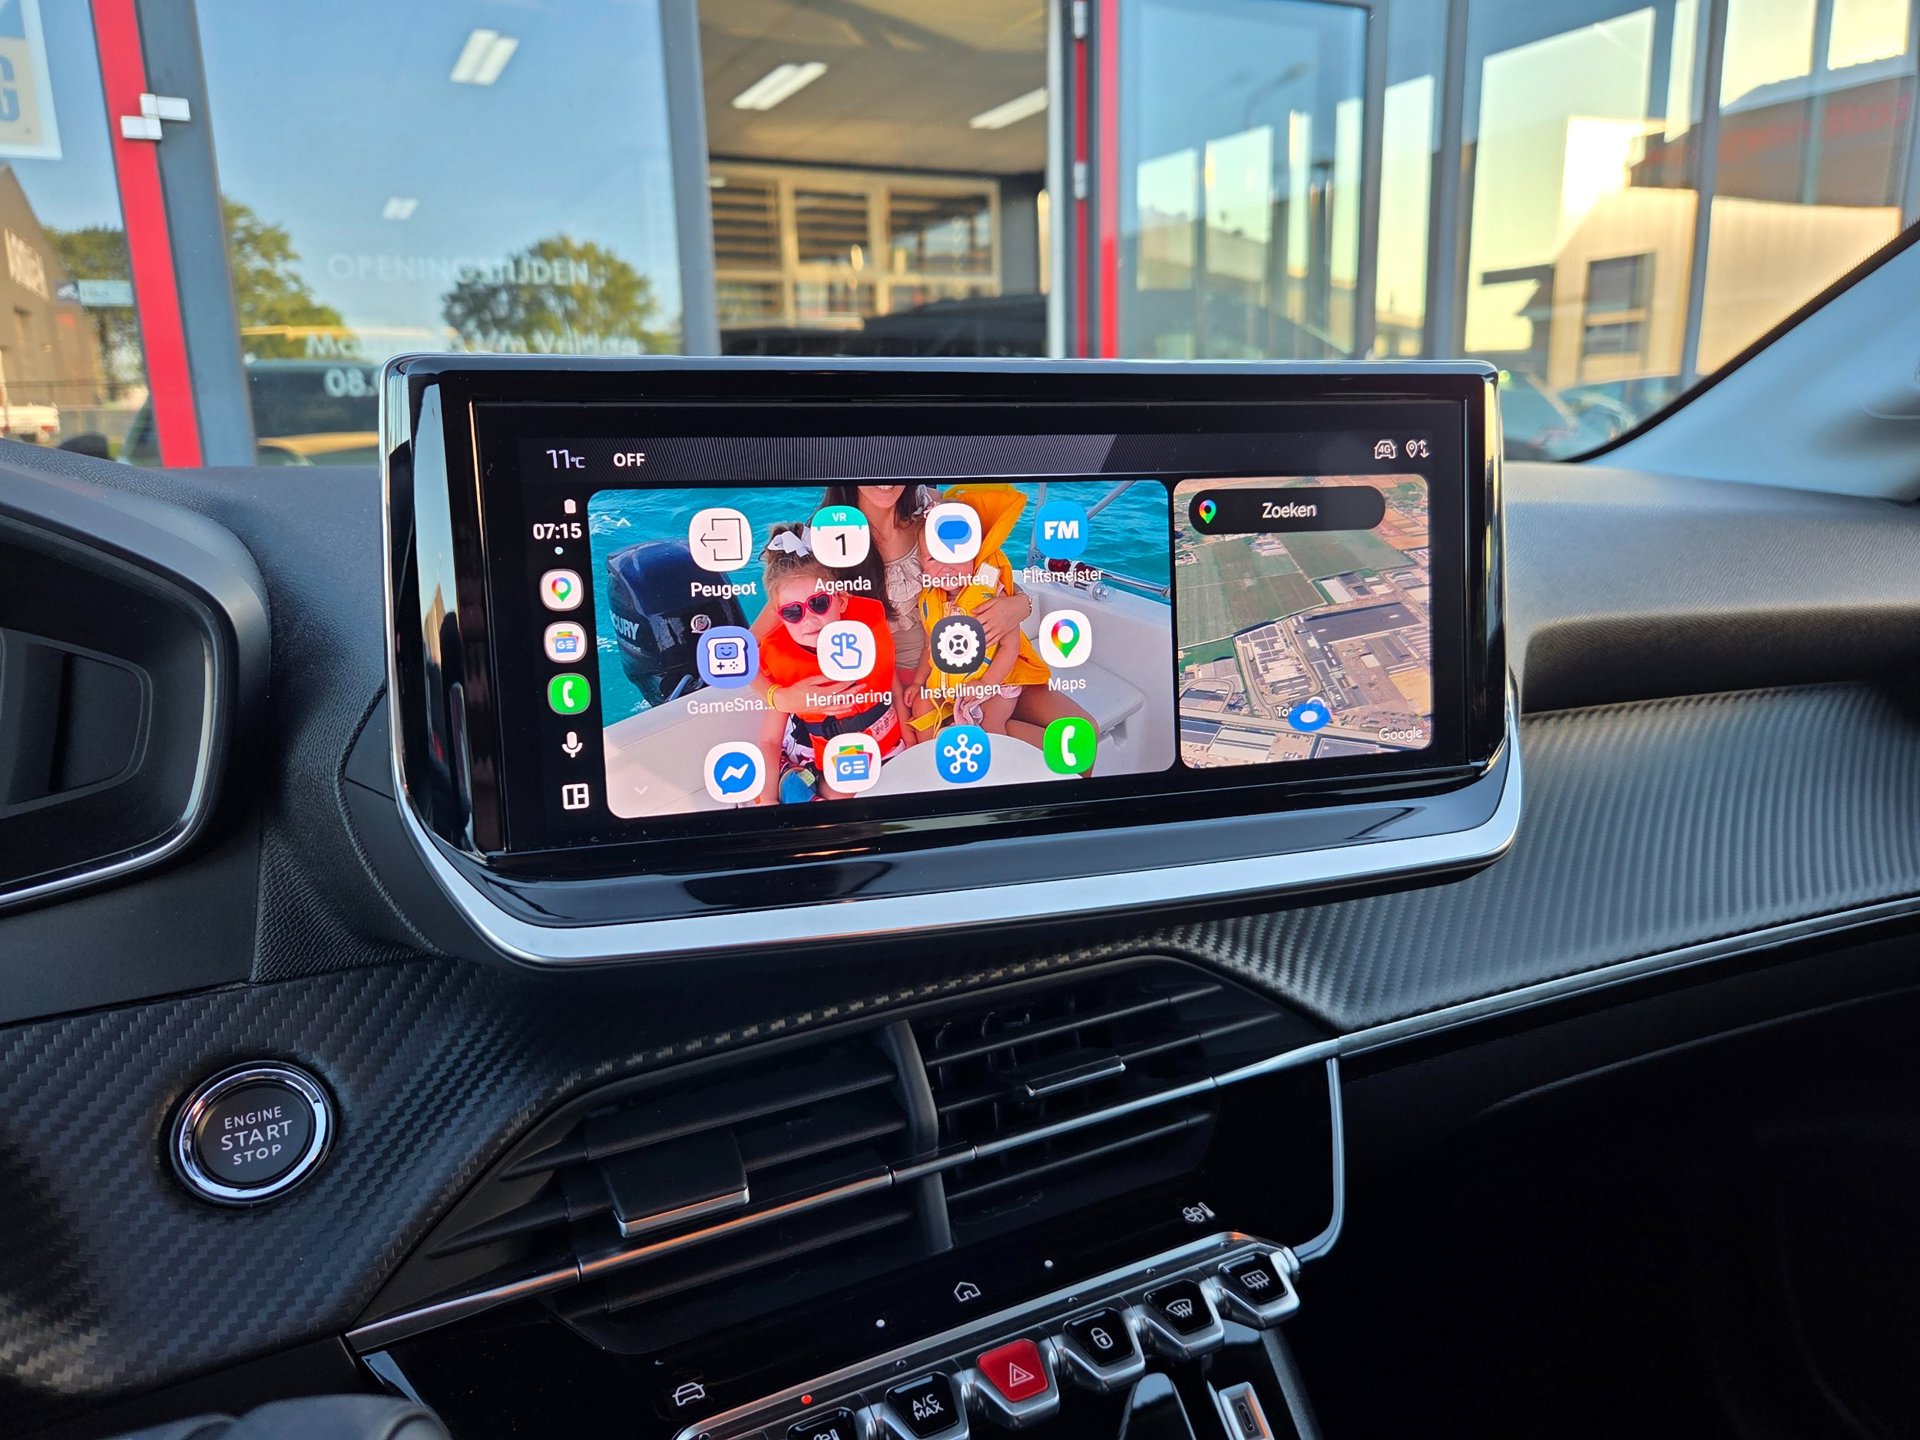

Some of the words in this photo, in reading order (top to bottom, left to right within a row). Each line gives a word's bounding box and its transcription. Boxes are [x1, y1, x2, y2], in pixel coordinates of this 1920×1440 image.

[324, 367, 382, 397] 08.
[613, 453, 645, 467] OFF
[831, 512, 847, 522] VR
[1262, 502, 1317, 519] Zoeken
[533, 523, 582, 540] 07:15
[1044, 520, 1079, 540] FM
[835, 533, 846, 556] 1
[815, 576, 872, 595] Agenda
[922, 569, 989, 588] Berichten
[1023, 568, 1103, 584] Flitsmeister
[691, 581, 757, 600] Peugeot
[920, 682, 1001, 700] Instellingen
[1048, 677, 1086, 692] Maps
[806, 689, 892, 707] Herinnering
[1378, 726, 1423, 742] Google
[224, 1106, 282, 1129] ENGINE
[221, 1120, 293, 1151] START
[233, 1144, 282, 1165] STOP
[912, 1393, 937, 1412] A/C
[914, 1401, 944, 1421] MAX
